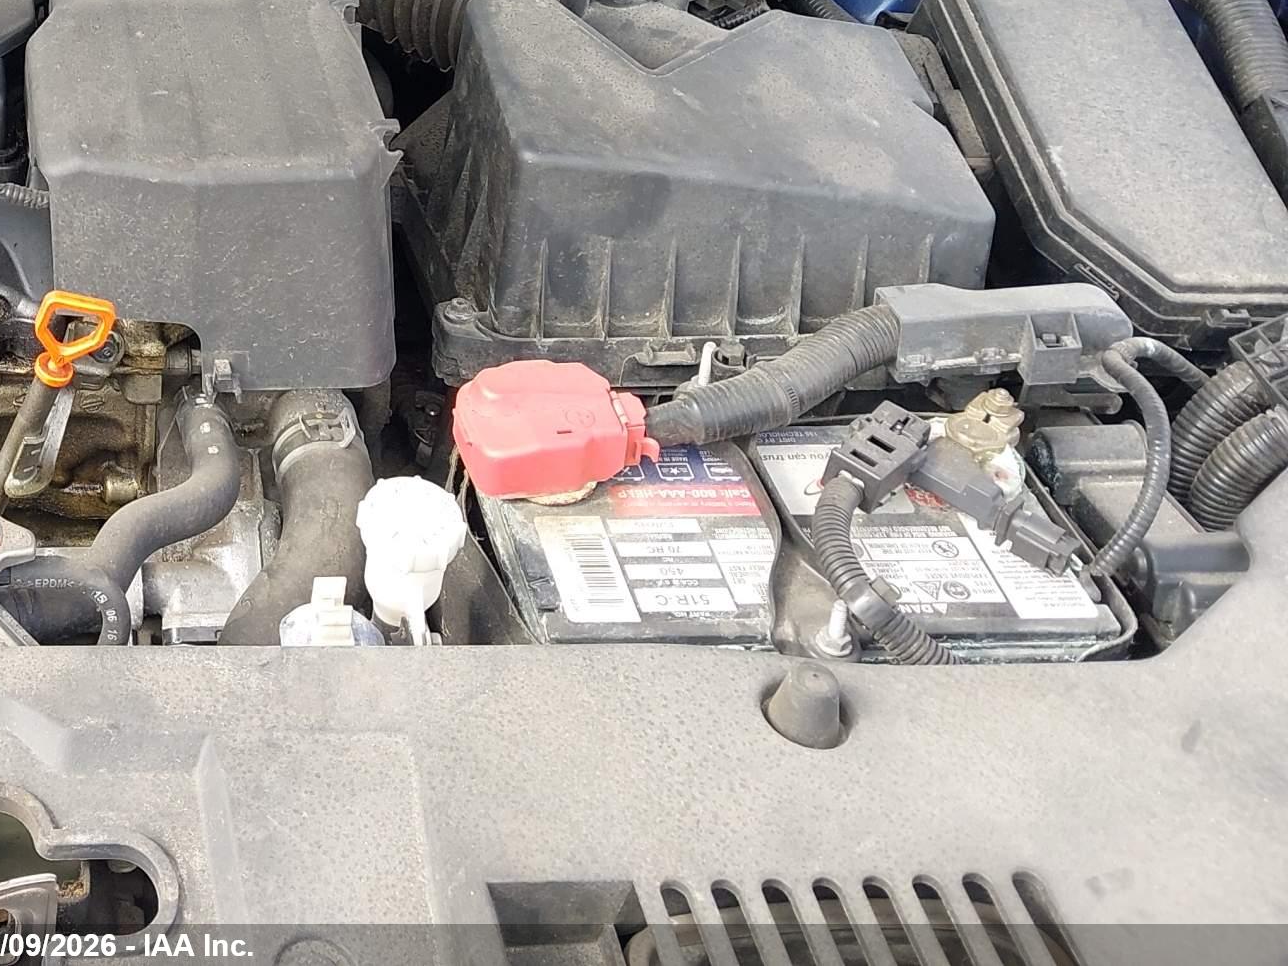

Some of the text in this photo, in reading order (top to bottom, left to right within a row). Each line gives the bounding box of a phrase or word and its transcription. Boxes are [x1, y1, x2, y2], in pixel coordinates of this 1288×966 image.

[810, 452, 830, 461] you
[719, 488, 751, 498] Call:
[655, 594, 711, 606] 51R-C
[897, 603, 934, 614] DAN
